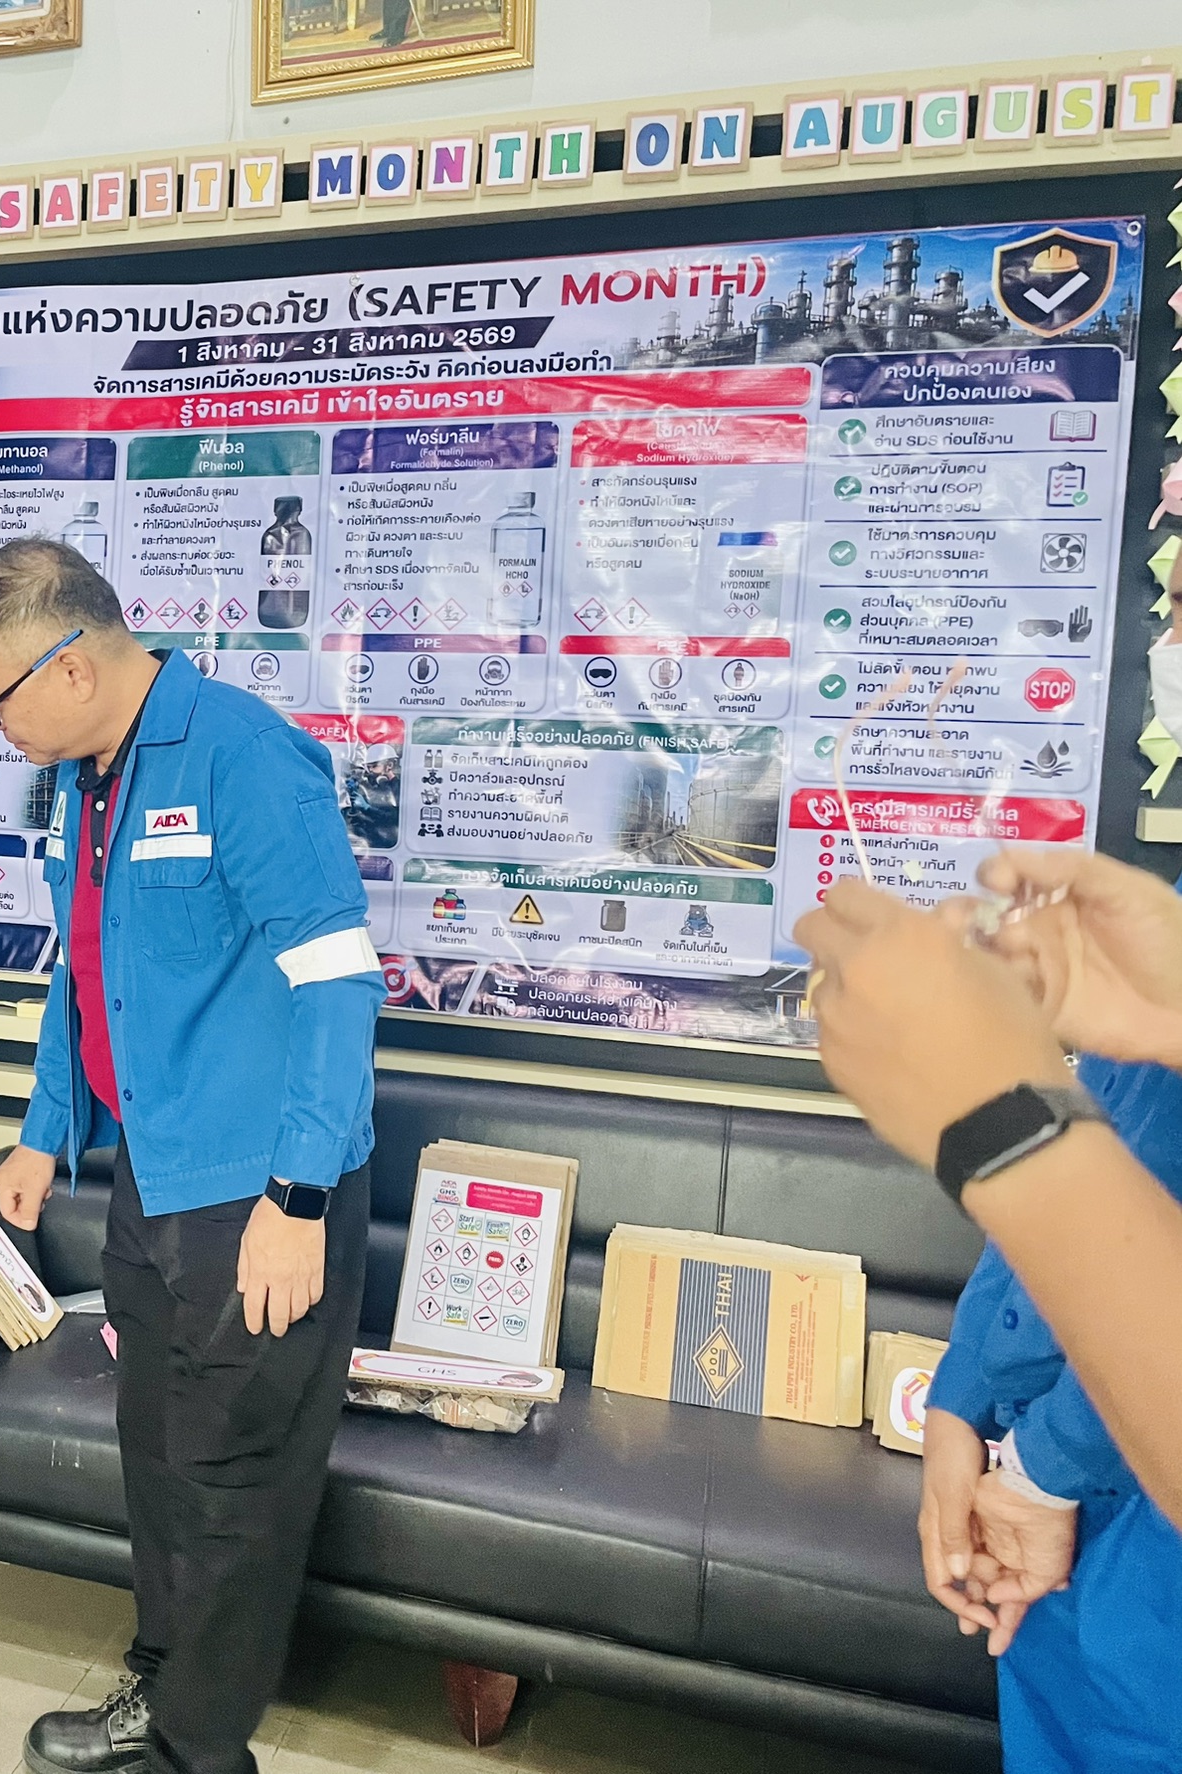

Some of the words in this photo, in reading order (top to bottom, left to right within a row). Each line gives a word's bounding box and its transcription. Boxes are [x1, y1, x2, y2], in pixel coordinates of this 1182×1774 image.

[316, 131, 583, 197] MONTH
[635, 114, 739, 167] ON
[793, 79, 1160, 149] AUGUST
[348, 275, 542, 321] (SAFETY
[560, 256, 767, 306] MONTH)
[177, 346, 187, 363] 1
[196, 340, 286, 362] สิงหาคม
[311, 337, 339, 354] 31
[348, 329, 445, 352] สิงหาคม
[452, 325, 517, 346] 2569
[94, 360, 430, 394] จัดการสารเคมีด้วยความระมัดระวัง
[437, 351, 612, 380] คิดก่อนลงมือทำ
[179, 388, 320, 427] รู้จักสารเคมี
[328, 385, 504, 414] เข้าใจอันตราย
[874, 434, 902, 447] อ่าน
[905, 435, 939, 447] SDS
[942, 431, 1014, 446] ก่อนใช้งาน
[419, 447, 465, 458] (Formalin)
[636, 453, 675, 462] Sodium
[198, 459, 245, 473] (Phenol)
[454, 458, 494, 469] Solution)
[869, 483, 938, 495] การทำงาน
[941, 482, 983, 495] (SOP)
[498, 558, 537, 567] FORMALIN
[375, 565, 399, 575] SDS
[505, 571, 529, 580] HCHO
[728, 569, 764, 578] SODIUM
[720, 580, 771, 590] HYDROXIDE
[729, 591, 760, 601] (NaOH)
[933, 615, 974, 629] (PPE)
[194, 635, 220, 647] PPE
[413, 637, 442, 649] PPE
[1029, 680, 1072, 699] STOP
[638, 735, 689, 748] (FINISH
[449, 771, 566, 787] ปิดวาล์วและอุปกรณ์
[153, 812, 189, 829] AICA
[447, 808, 569, 824] รายงานความผิดปกติ
[446, 825, 593, 844] ส่งมอบงานอย่างปลอดภัย
[452, 1276, 470, 1286] ZERO
[715, 1272, 734, 1317] THAI
[505, 1318, 524, 1328] ZERO
[418, 1366, 457, 1376] GHS
